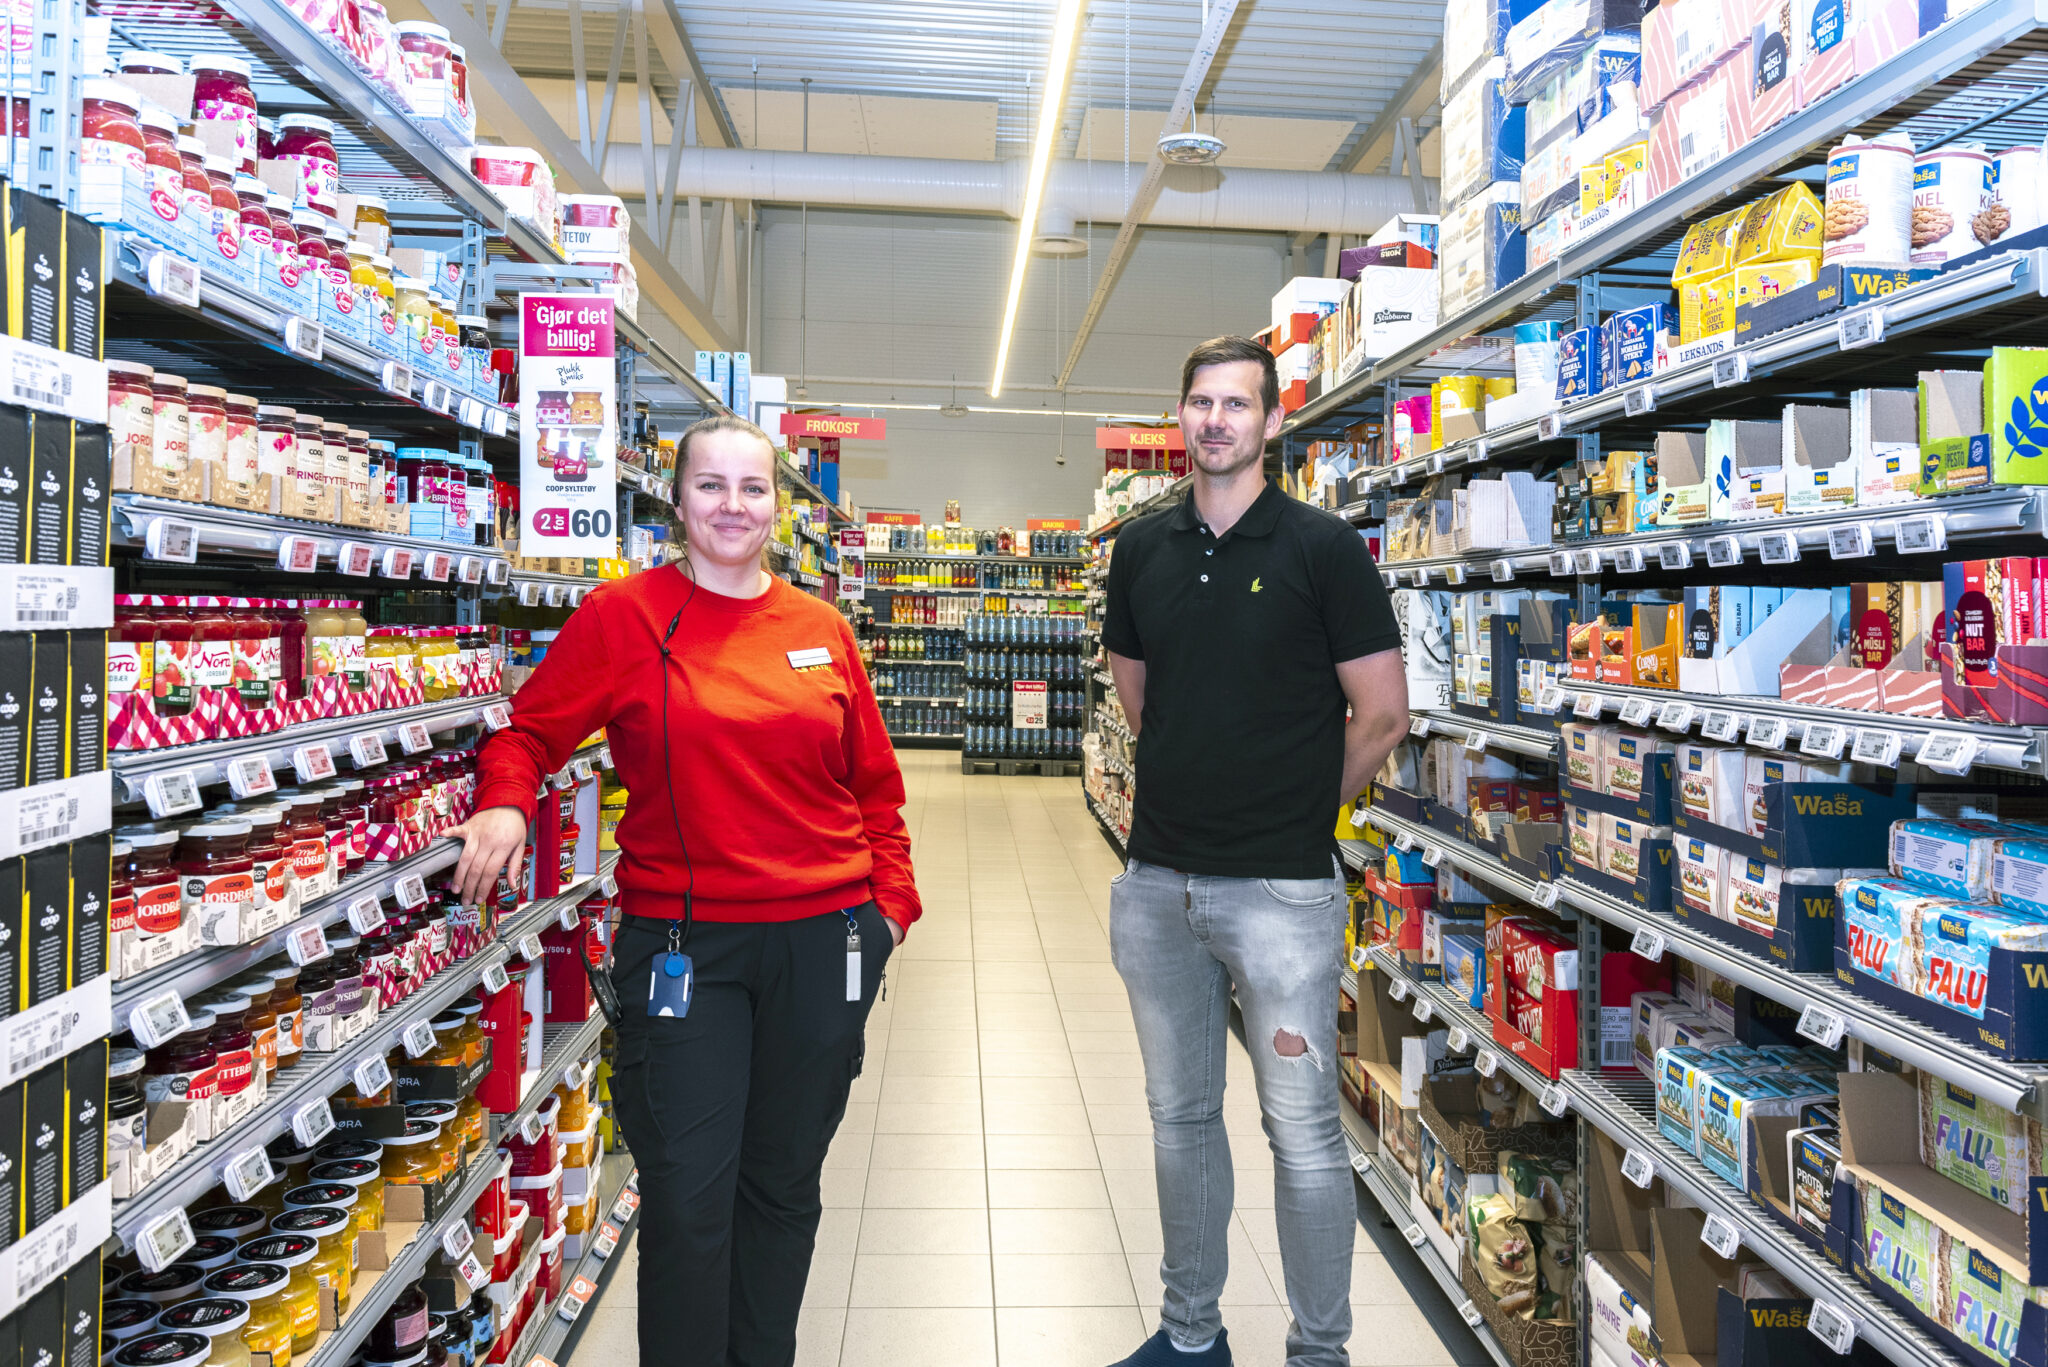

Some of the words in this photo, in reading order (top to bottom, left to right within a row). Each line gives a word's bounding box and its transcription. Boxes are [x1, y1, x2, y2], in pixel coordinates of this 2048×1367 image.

[1819, 31, 1835, 49] BAR
[1763, 53, 1782, 74] MÜSLI
[1766, 65, 1780, 83] BAR
[1828, 159, 1857, 177] Wasa
[1827, 183, 1863, 201] ANEL
[1914, 190, 1945, 207] NEL
[1579, 207, 1610, 230] LEKSANDS
[562, 232, 591, 244] TETØY
[1817, 286, 1837, 301] Wasa
[536, 305, 574, 331] Gjør
[577, 306, 608, 326] det
[1375, 311, 1413, 325] Stabburet
[1737, 320, 1752, 334] Wasa
[546, 329, 596, 351] billig!
[1620, 341, 1648, 354] NORMAL
[1623, 350, 1644, 362] STEKT
[1679, 339, 1725, 363] LEKSANDS
[555, 363, 582, 378] Plukk
[1561, 361, 1582, 373] NORMAL
[559, 377, 567, 386] &
[566, 371, 584, 382] miks
[806, 419, 861, 435] FROKOST
[1129, 433, 1167, 446] KJEKS
[1173, 456, 1185, 467] det
[1945, 451, 1965, 469] PESTO
[564, 485, 597, 493] SYLTETØY
[1732, 500, 1754, 512] BRUNOST
[540, 513, 551, 530] 2
[552, 514, 565, 531] for
[571, 508, 612, 538] 60
[883, 515, 904, 523] KAFFE
[1041, 521, 1065, 529] BAKING
[851, 584, 862, 592] 99
[2021, 590, 2029, 612] BAR
[1693, 630, 1710, 641] MÜSLI
[1965, 623, 1985, 637] NUT
[1695, 641, 1707, 651] BAR
[1863, 637, 1886, 651] MÜSLI
[1966, 638, 1986, 651] BAR
[108, 654, 138, 673] ora
[194, 651, 232, 669] Nora
[1636, 653, 1658, 672] CORNY
[1866, 651, 1882, 662] BAR
[1990, 659, 1997, 670] 3
[1573, 737, 1585, 746] Wasa
[1619, 744, 1635, 755] Wasa
[1689, 755, 1702, 766] Wasa
[1765, 767, 1783, 778] Wasa
[1792, 793, 1863, 816] Wasa
[1617, 828, 1631, 838] Wasa
[1690, 844, 1704, 857] Wasa
[1698, 864, 1716, 880] FULLKORN
[1747, 865, 1764, 877] Wasa
[1730, 877, 1752, 890] FRUKOST
[1752, 884, 1780, 903] FULLKORN
[1857, 889, 1876, 908] Wasa
[82, 901, 100, 912] coop
[1803, 897, 1836, 919] Wa
[40, 914, 60, 927] coop
[449, 907, 480, 924] Nora
[1940, 917, 1966, 938] Wasa
[1769, 943, 1787, 961] Wasa
[1848, 924, 1890, 973] FALU
[1513, 944, 1545, 975] RYVITA
[1424, 968, 1441, 978] Wa
[1836, 967, 1855, 986] Wasa
[1928, 957, 1988, 1009] FALU
[1511, 1040, 1526, 1052] RYVITA
[1977, 1027, 2006, 1051] Wasa
[1668, 1065, 1684, 1081] Wasa
[1666, 1082, 1682, 1105] 100
[1711, 1090, 1729, 1110] Wasa
[77, 1105, 96, 1123] coop
[1710, 1110, 1728, 1136] 100
[35, 1131, 54, 1148] coop
[1935, 1114, 1993, 1171] FALU
[1803, 1146, 1824, 1169] Wasa
[1883, 1196, 1904, 1221] Wasa
[1822, 1243, 1843, 1266] Wasa
[1868, 1228, 1917, 1290] FALU
[1971, 1255, 1999, 1284] Wasa
[1596, 1296, 1622, 1333] HAVRE
[1954, 1289, 2019, 1361] FALU
